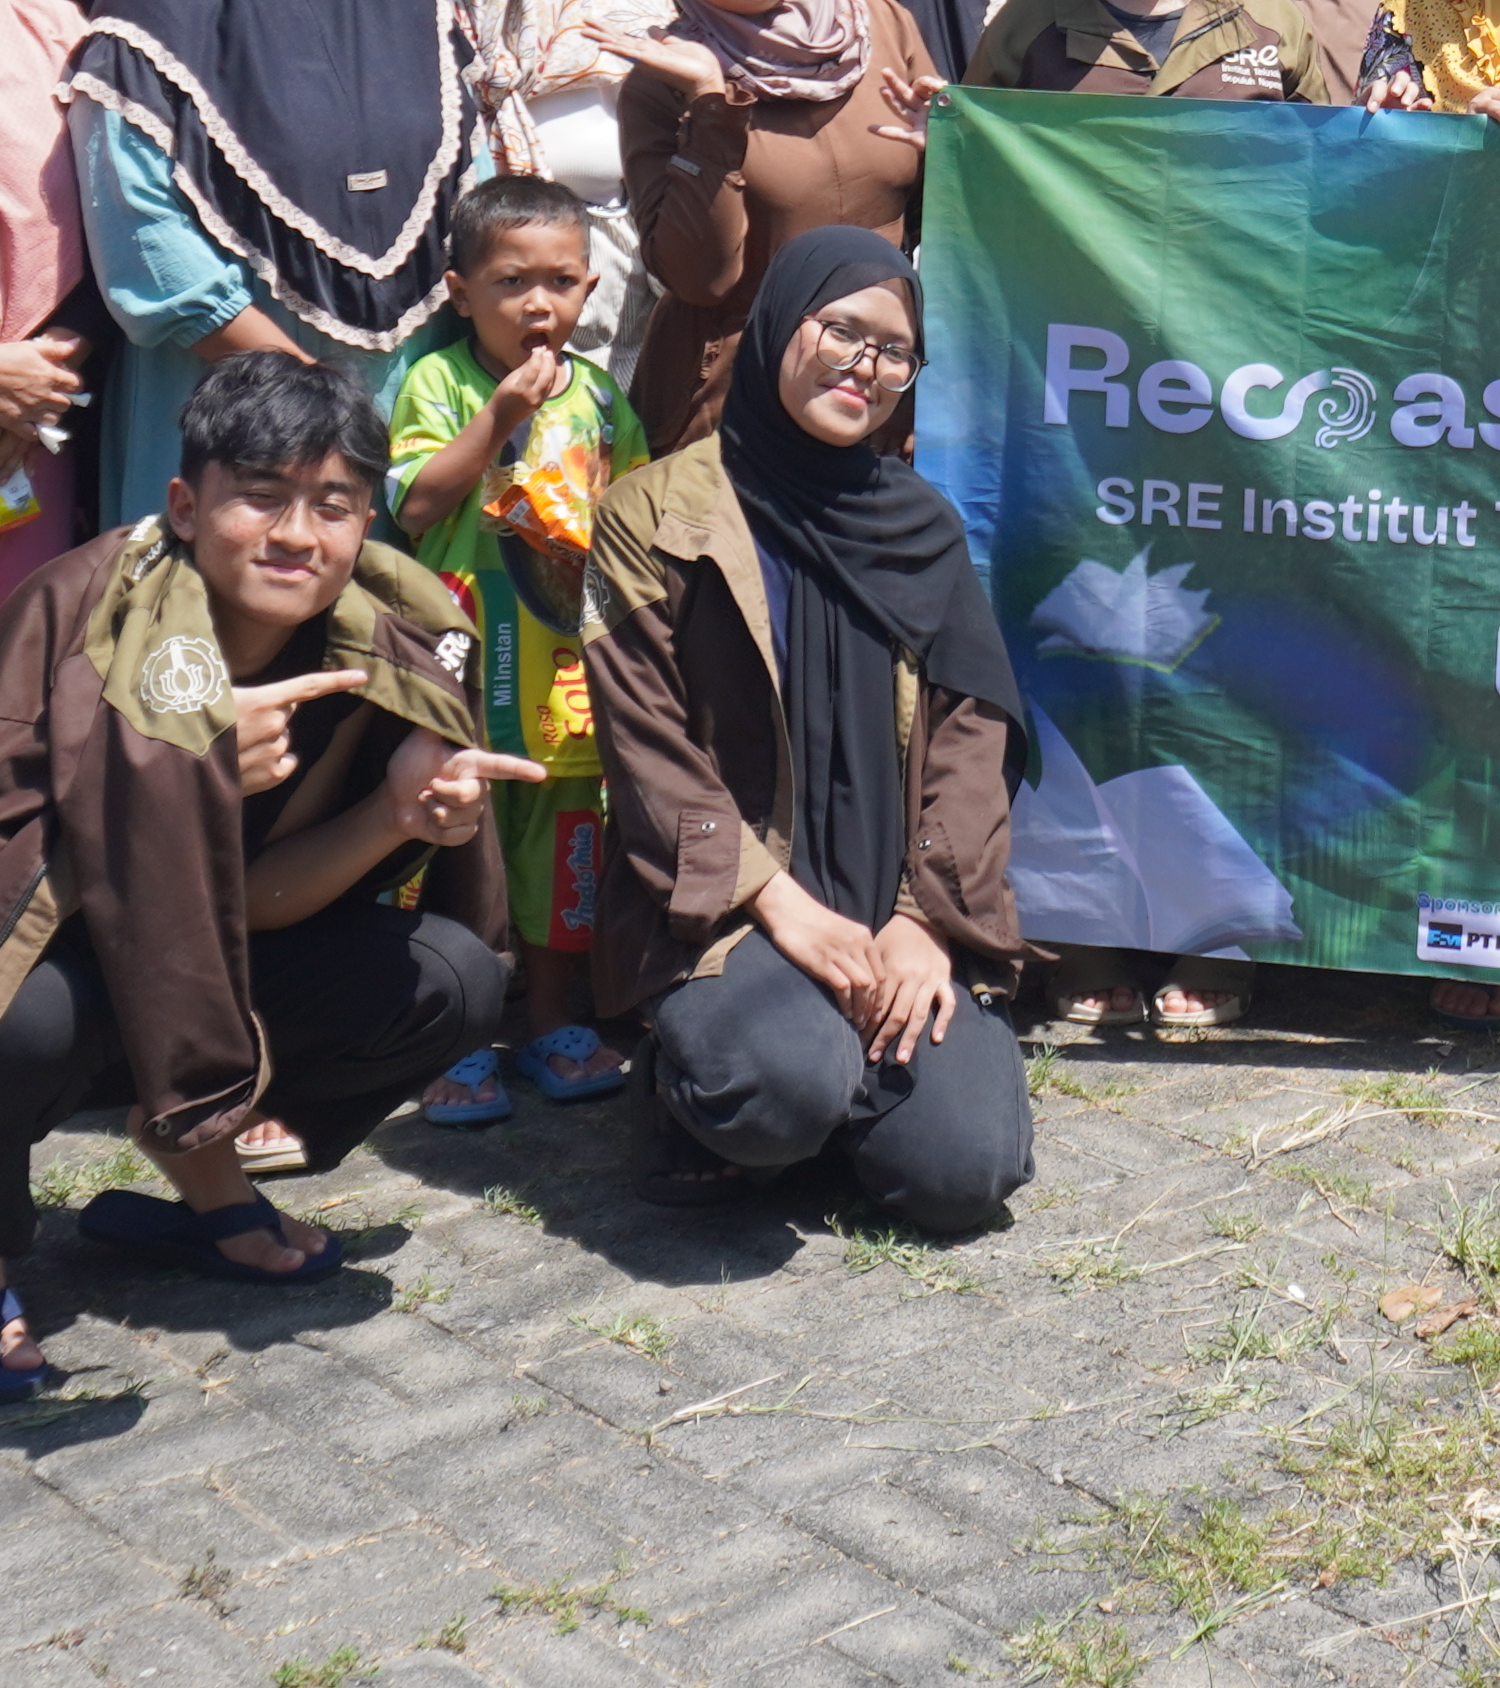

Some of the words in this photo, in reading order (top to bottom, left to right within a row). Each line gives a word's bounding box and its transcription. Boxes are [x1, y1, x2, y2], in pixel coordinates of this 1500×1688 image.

[1094, 476, 1224, 531] SRE
[1242, 488, 1478, 549] Institut
[493, 622, 512, 681] Instan
[551, 647, 595, 740] Soto
[1466, 932, 1497, 949] PT
